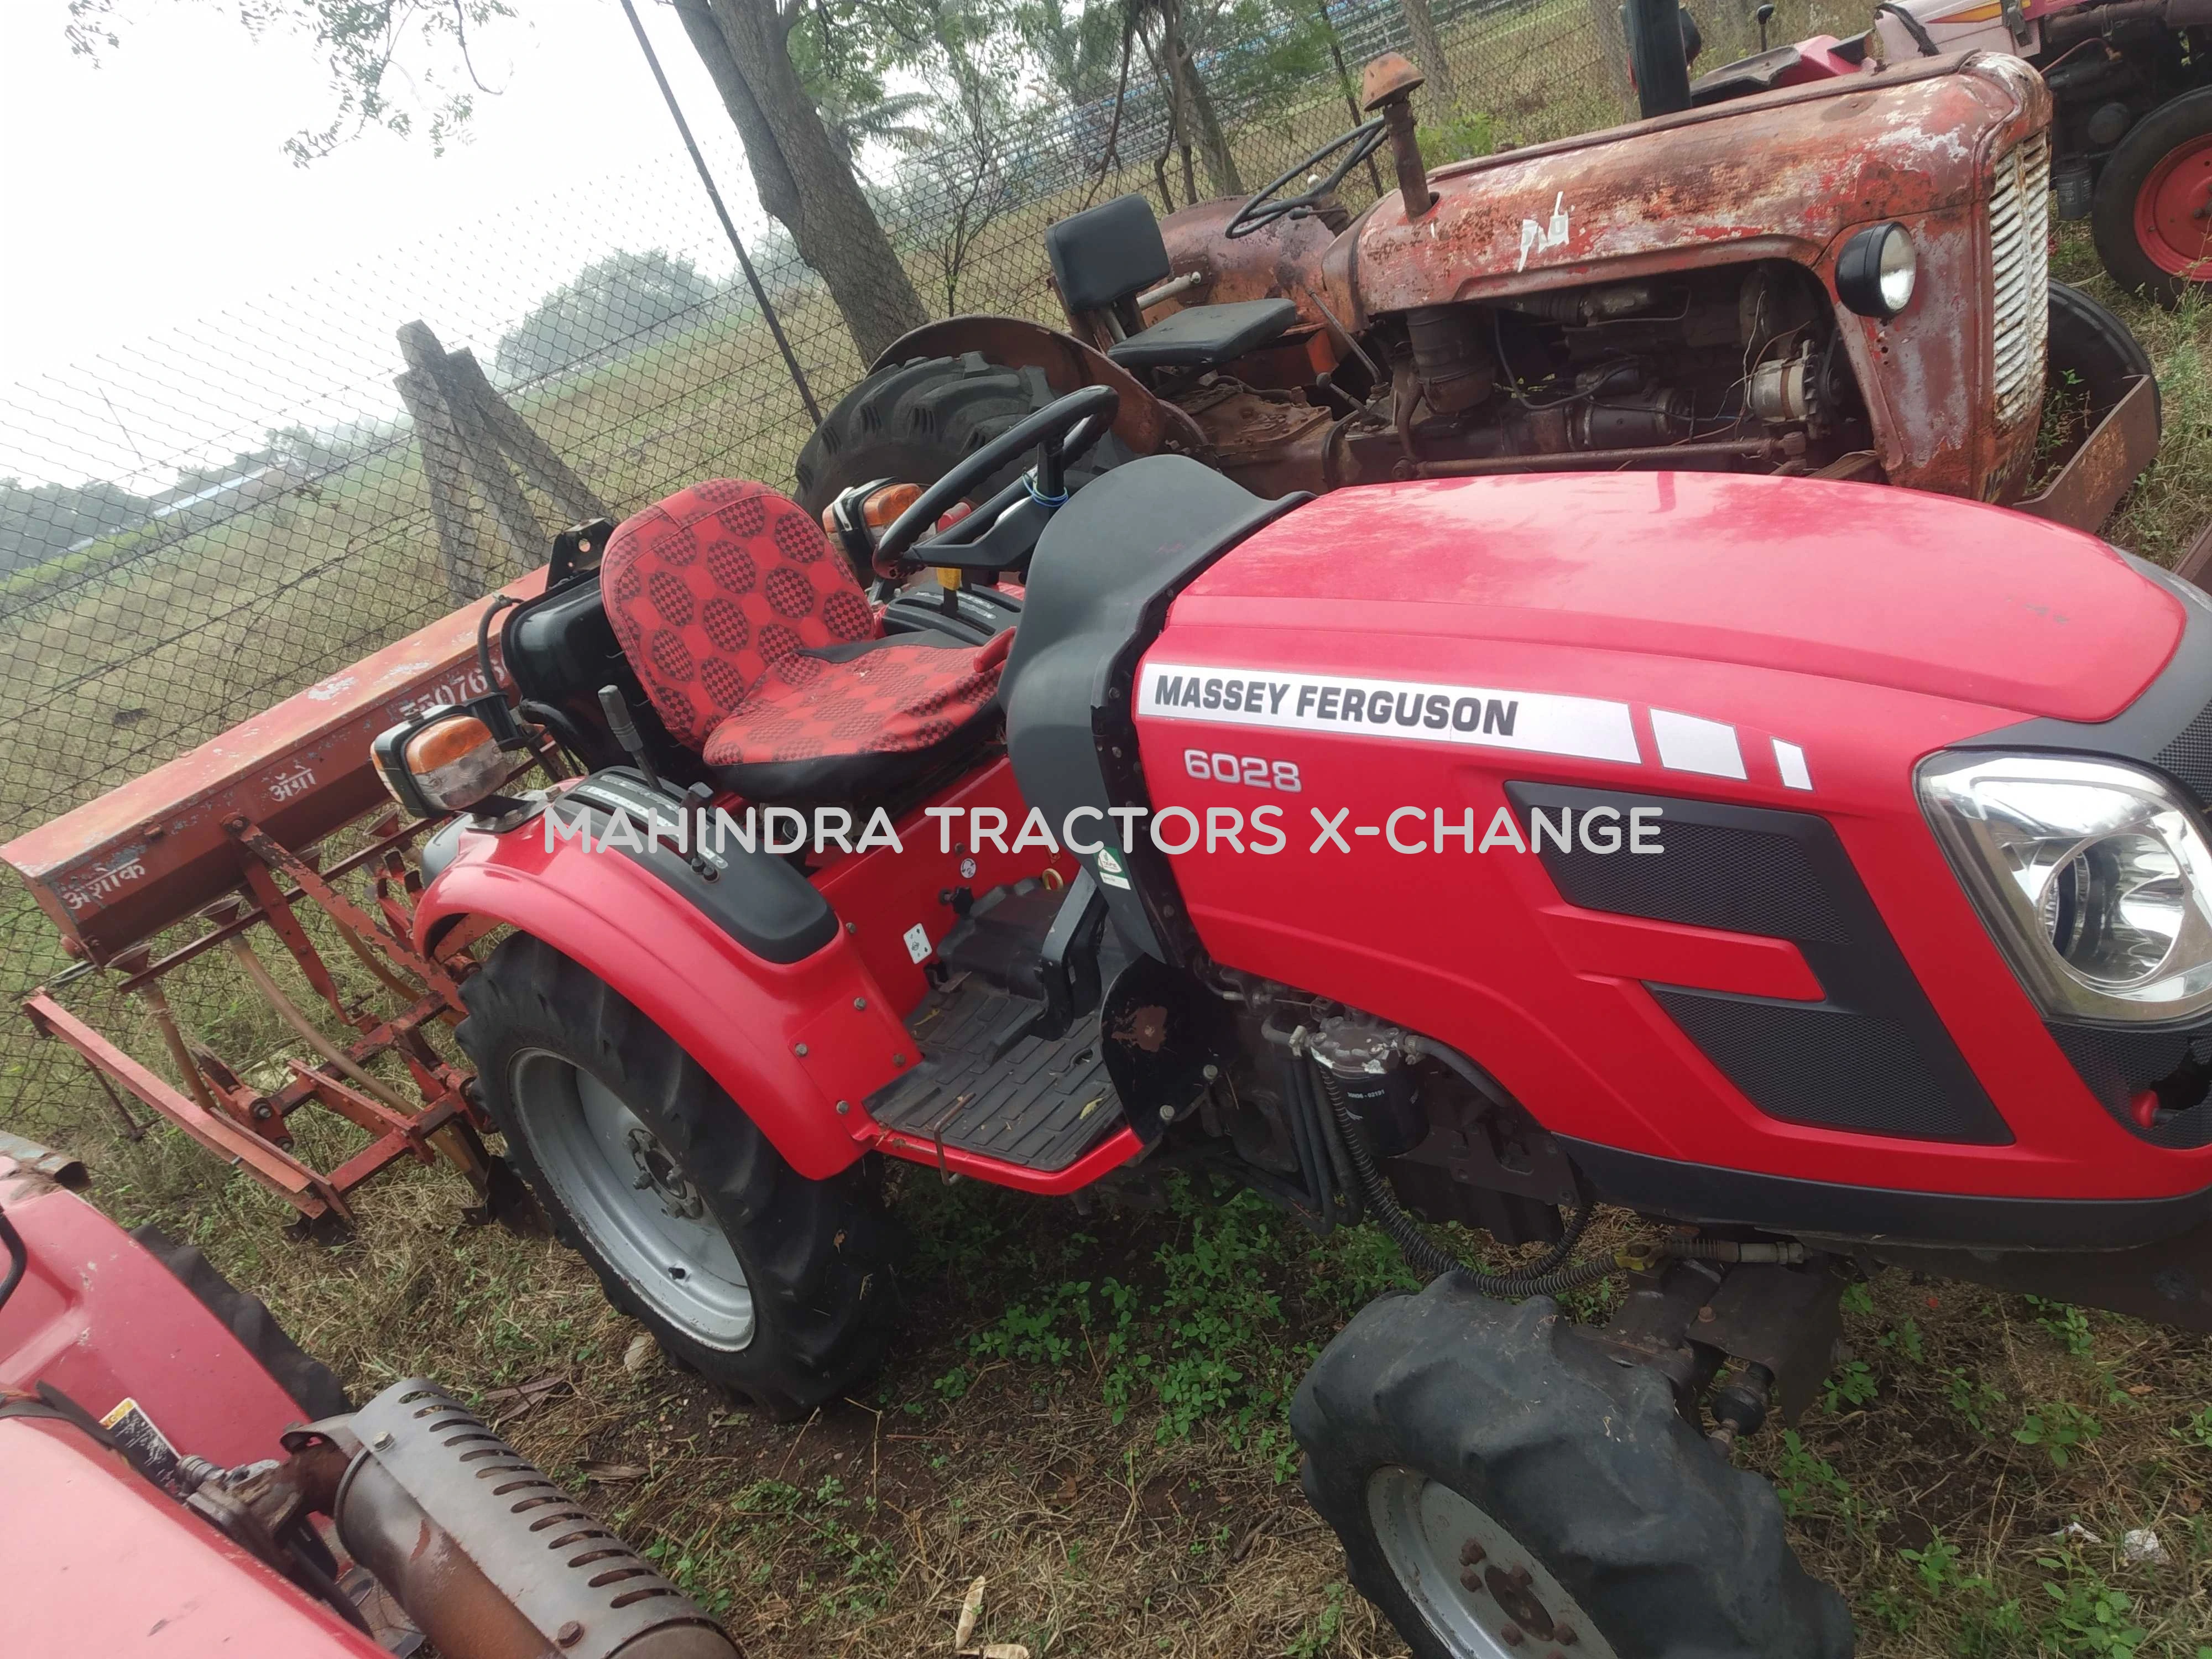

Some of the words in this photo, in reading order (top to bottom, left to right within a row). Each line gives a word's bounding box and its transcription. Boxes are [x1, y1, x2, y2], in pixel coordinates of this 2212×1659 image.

[1155, 675, 1290, 716] MASSEY
[1296, 685, 1519, 736] FERGUSON
[1184, 749, 1302, 793] 6028
